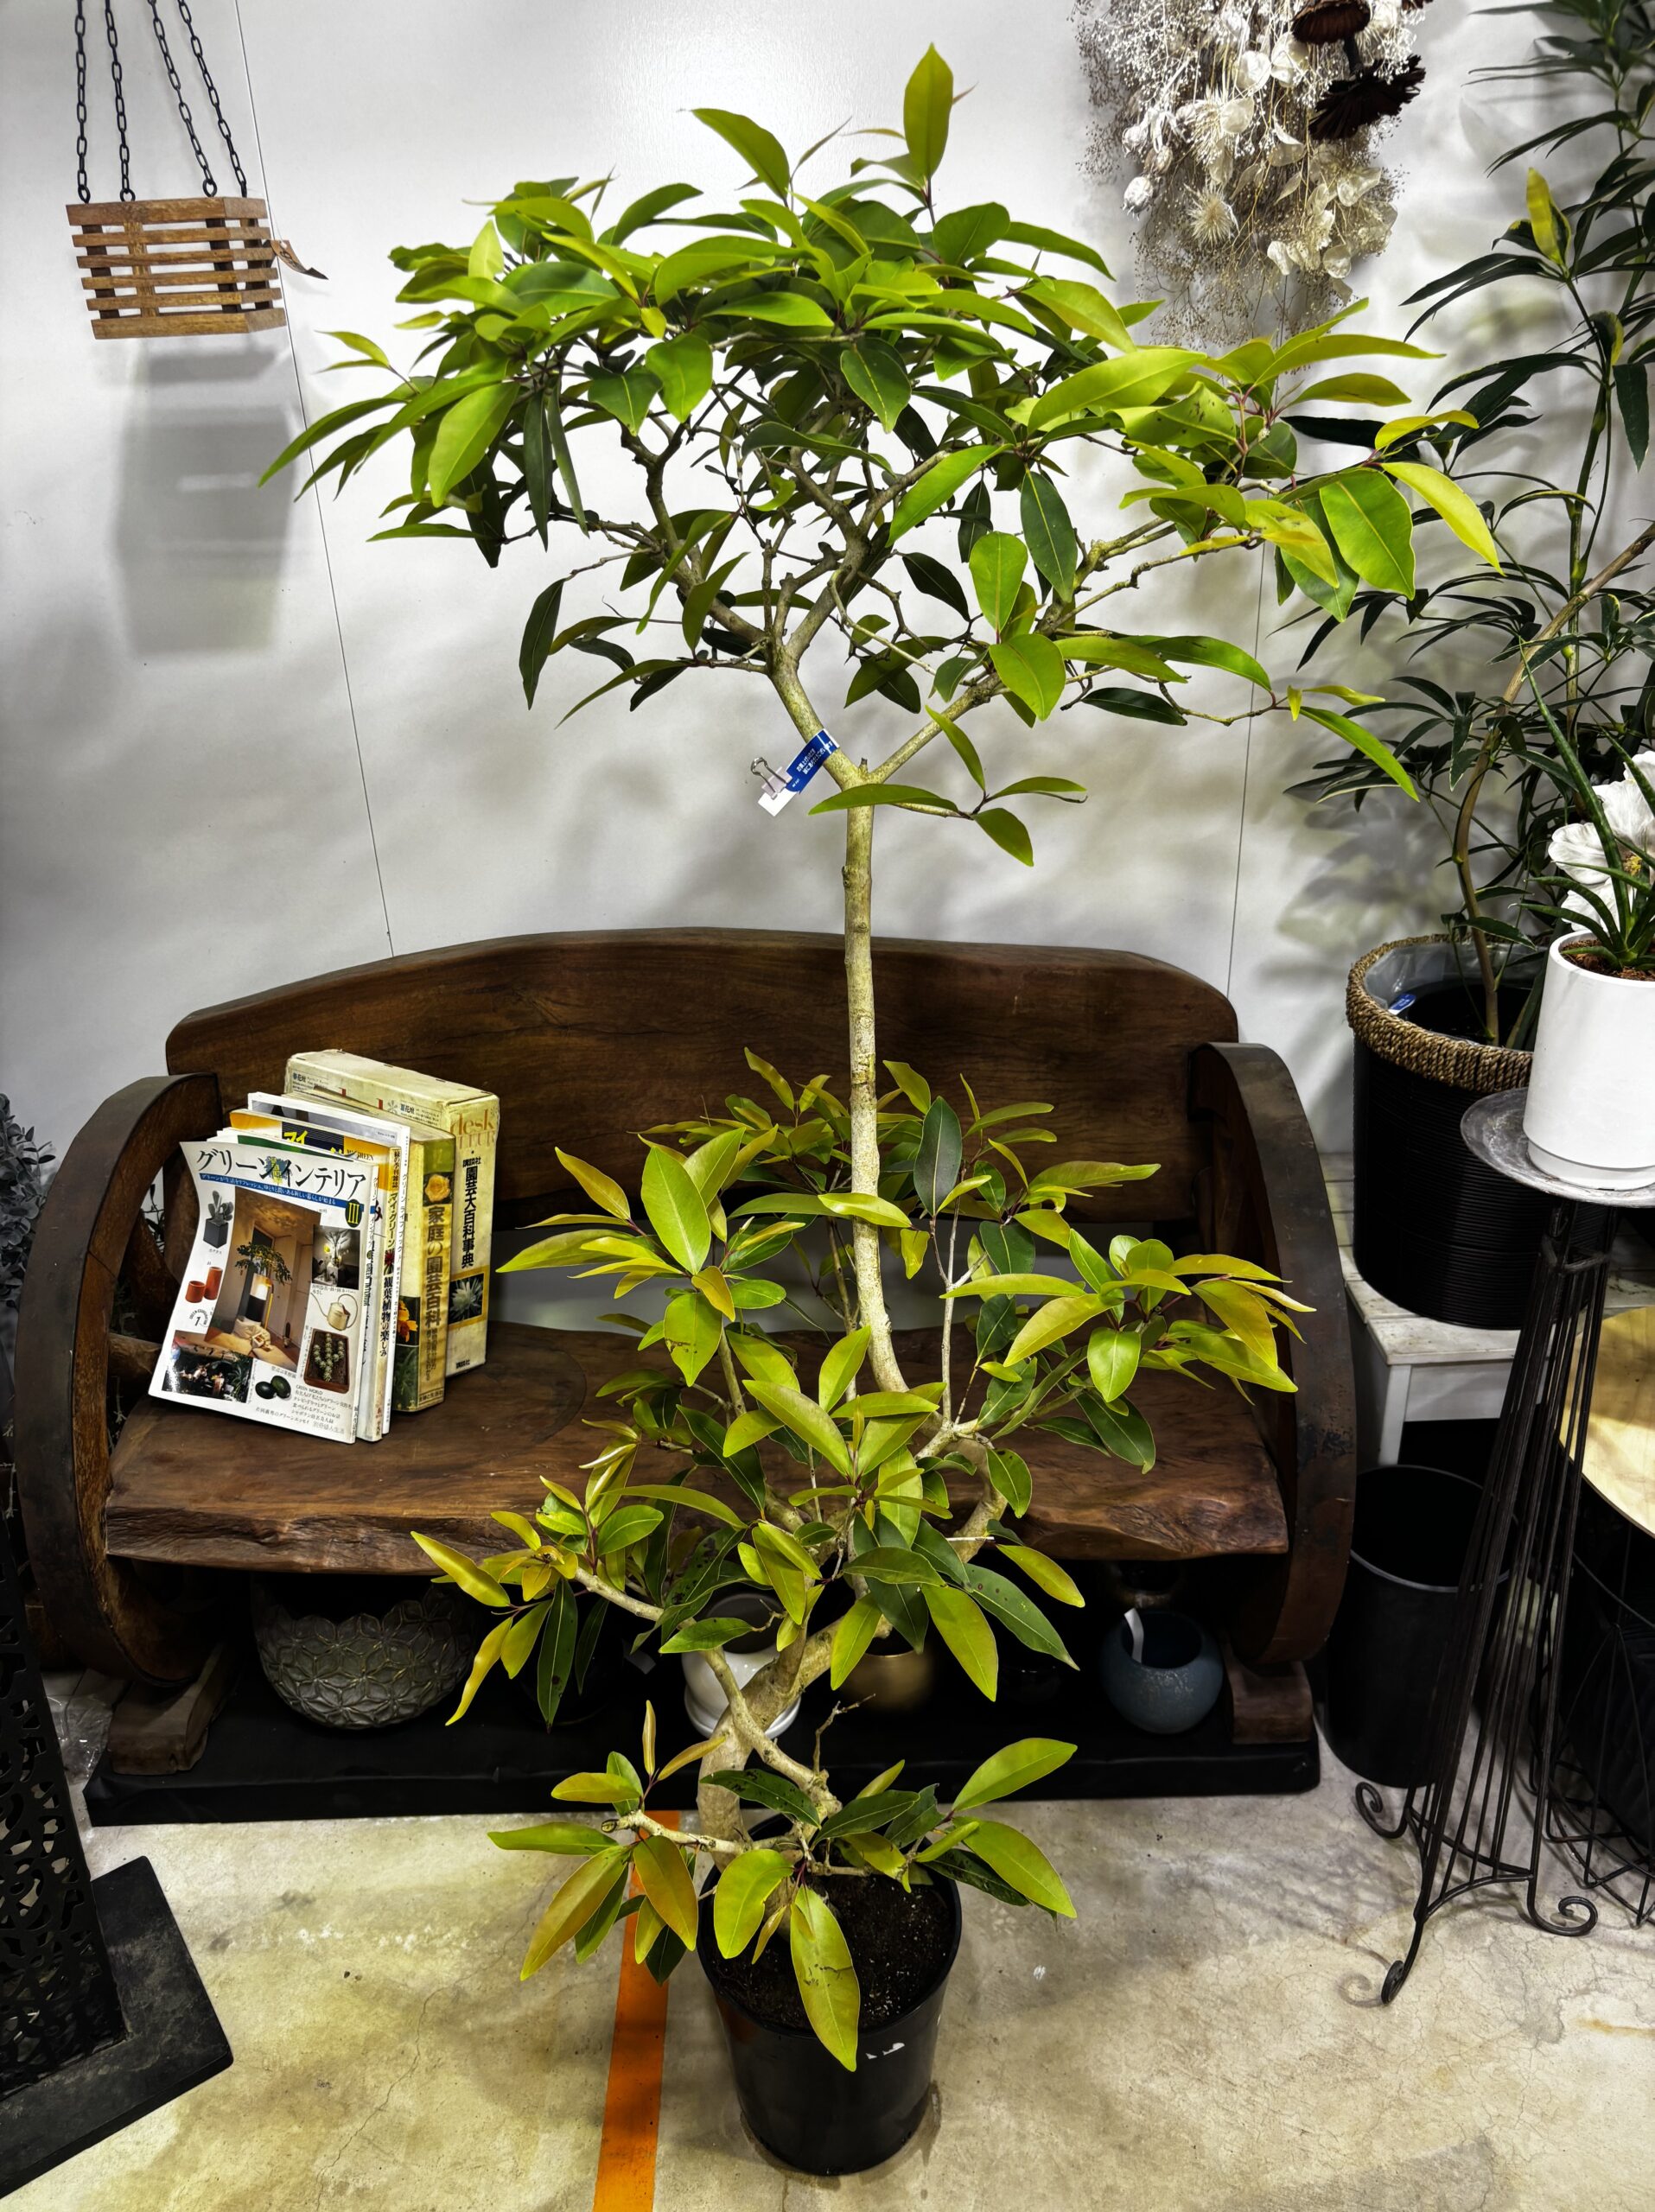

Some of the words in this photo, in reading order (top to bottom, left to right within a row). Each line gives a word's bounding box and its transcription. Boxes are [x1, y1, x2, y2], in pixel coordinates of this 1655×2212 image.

[462, 1157, 481, 1168] 講談社
[461, 1166, 478, 1269] 園芸大百科事典
[426, 1206, 445, 1326] 家庭の園芸百科
[455, 1359, 470, 1370] 講談社
